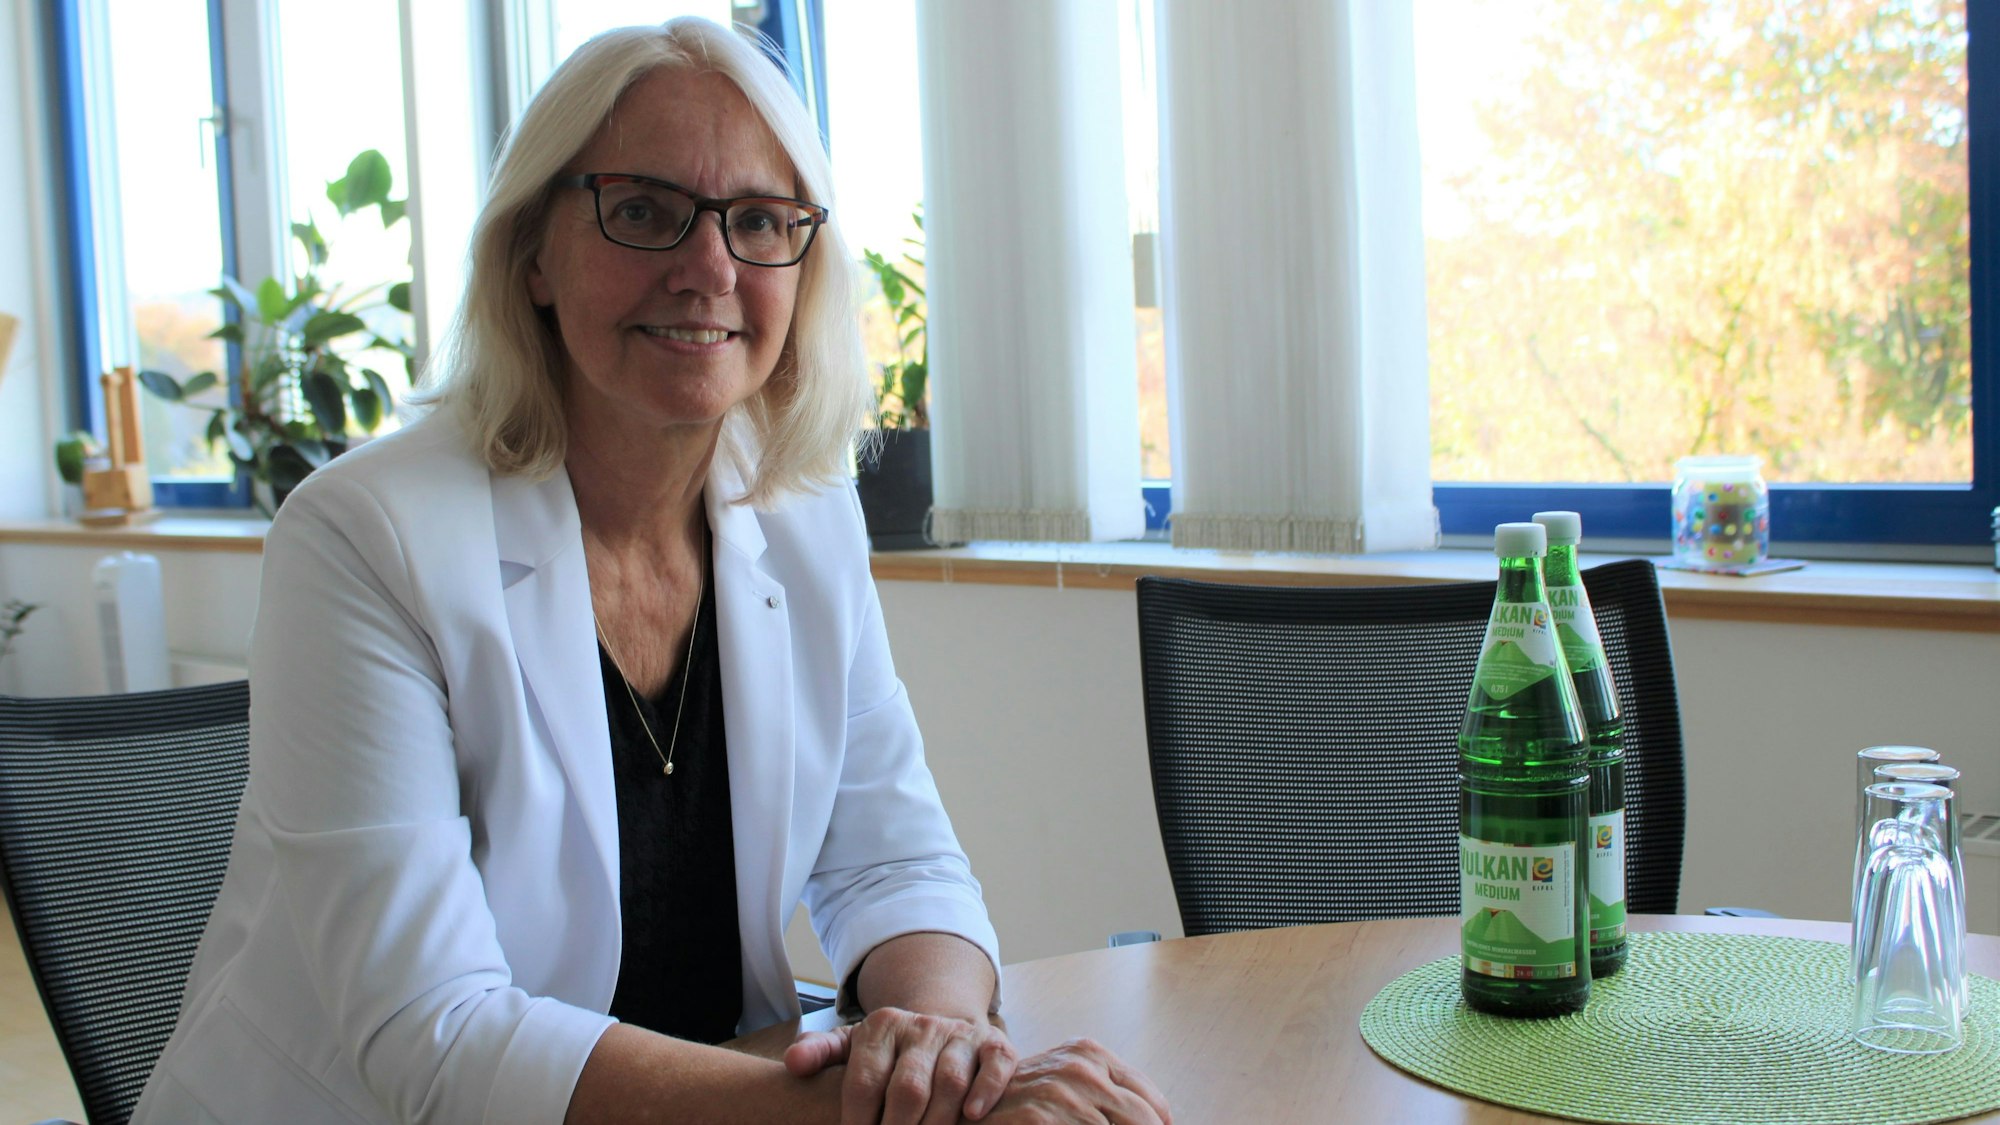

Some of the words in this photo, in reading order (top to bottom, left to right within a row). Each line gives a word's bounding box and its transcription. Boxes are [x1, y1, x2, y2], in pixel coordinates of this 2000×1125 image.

[1548, 589, 1579, 607] KAN
[1494, 605, 1533, 625] LKAN
[1552, 609, 1575, 621] DIUM
[1475, 882, 1520, 901] MEDIUM
